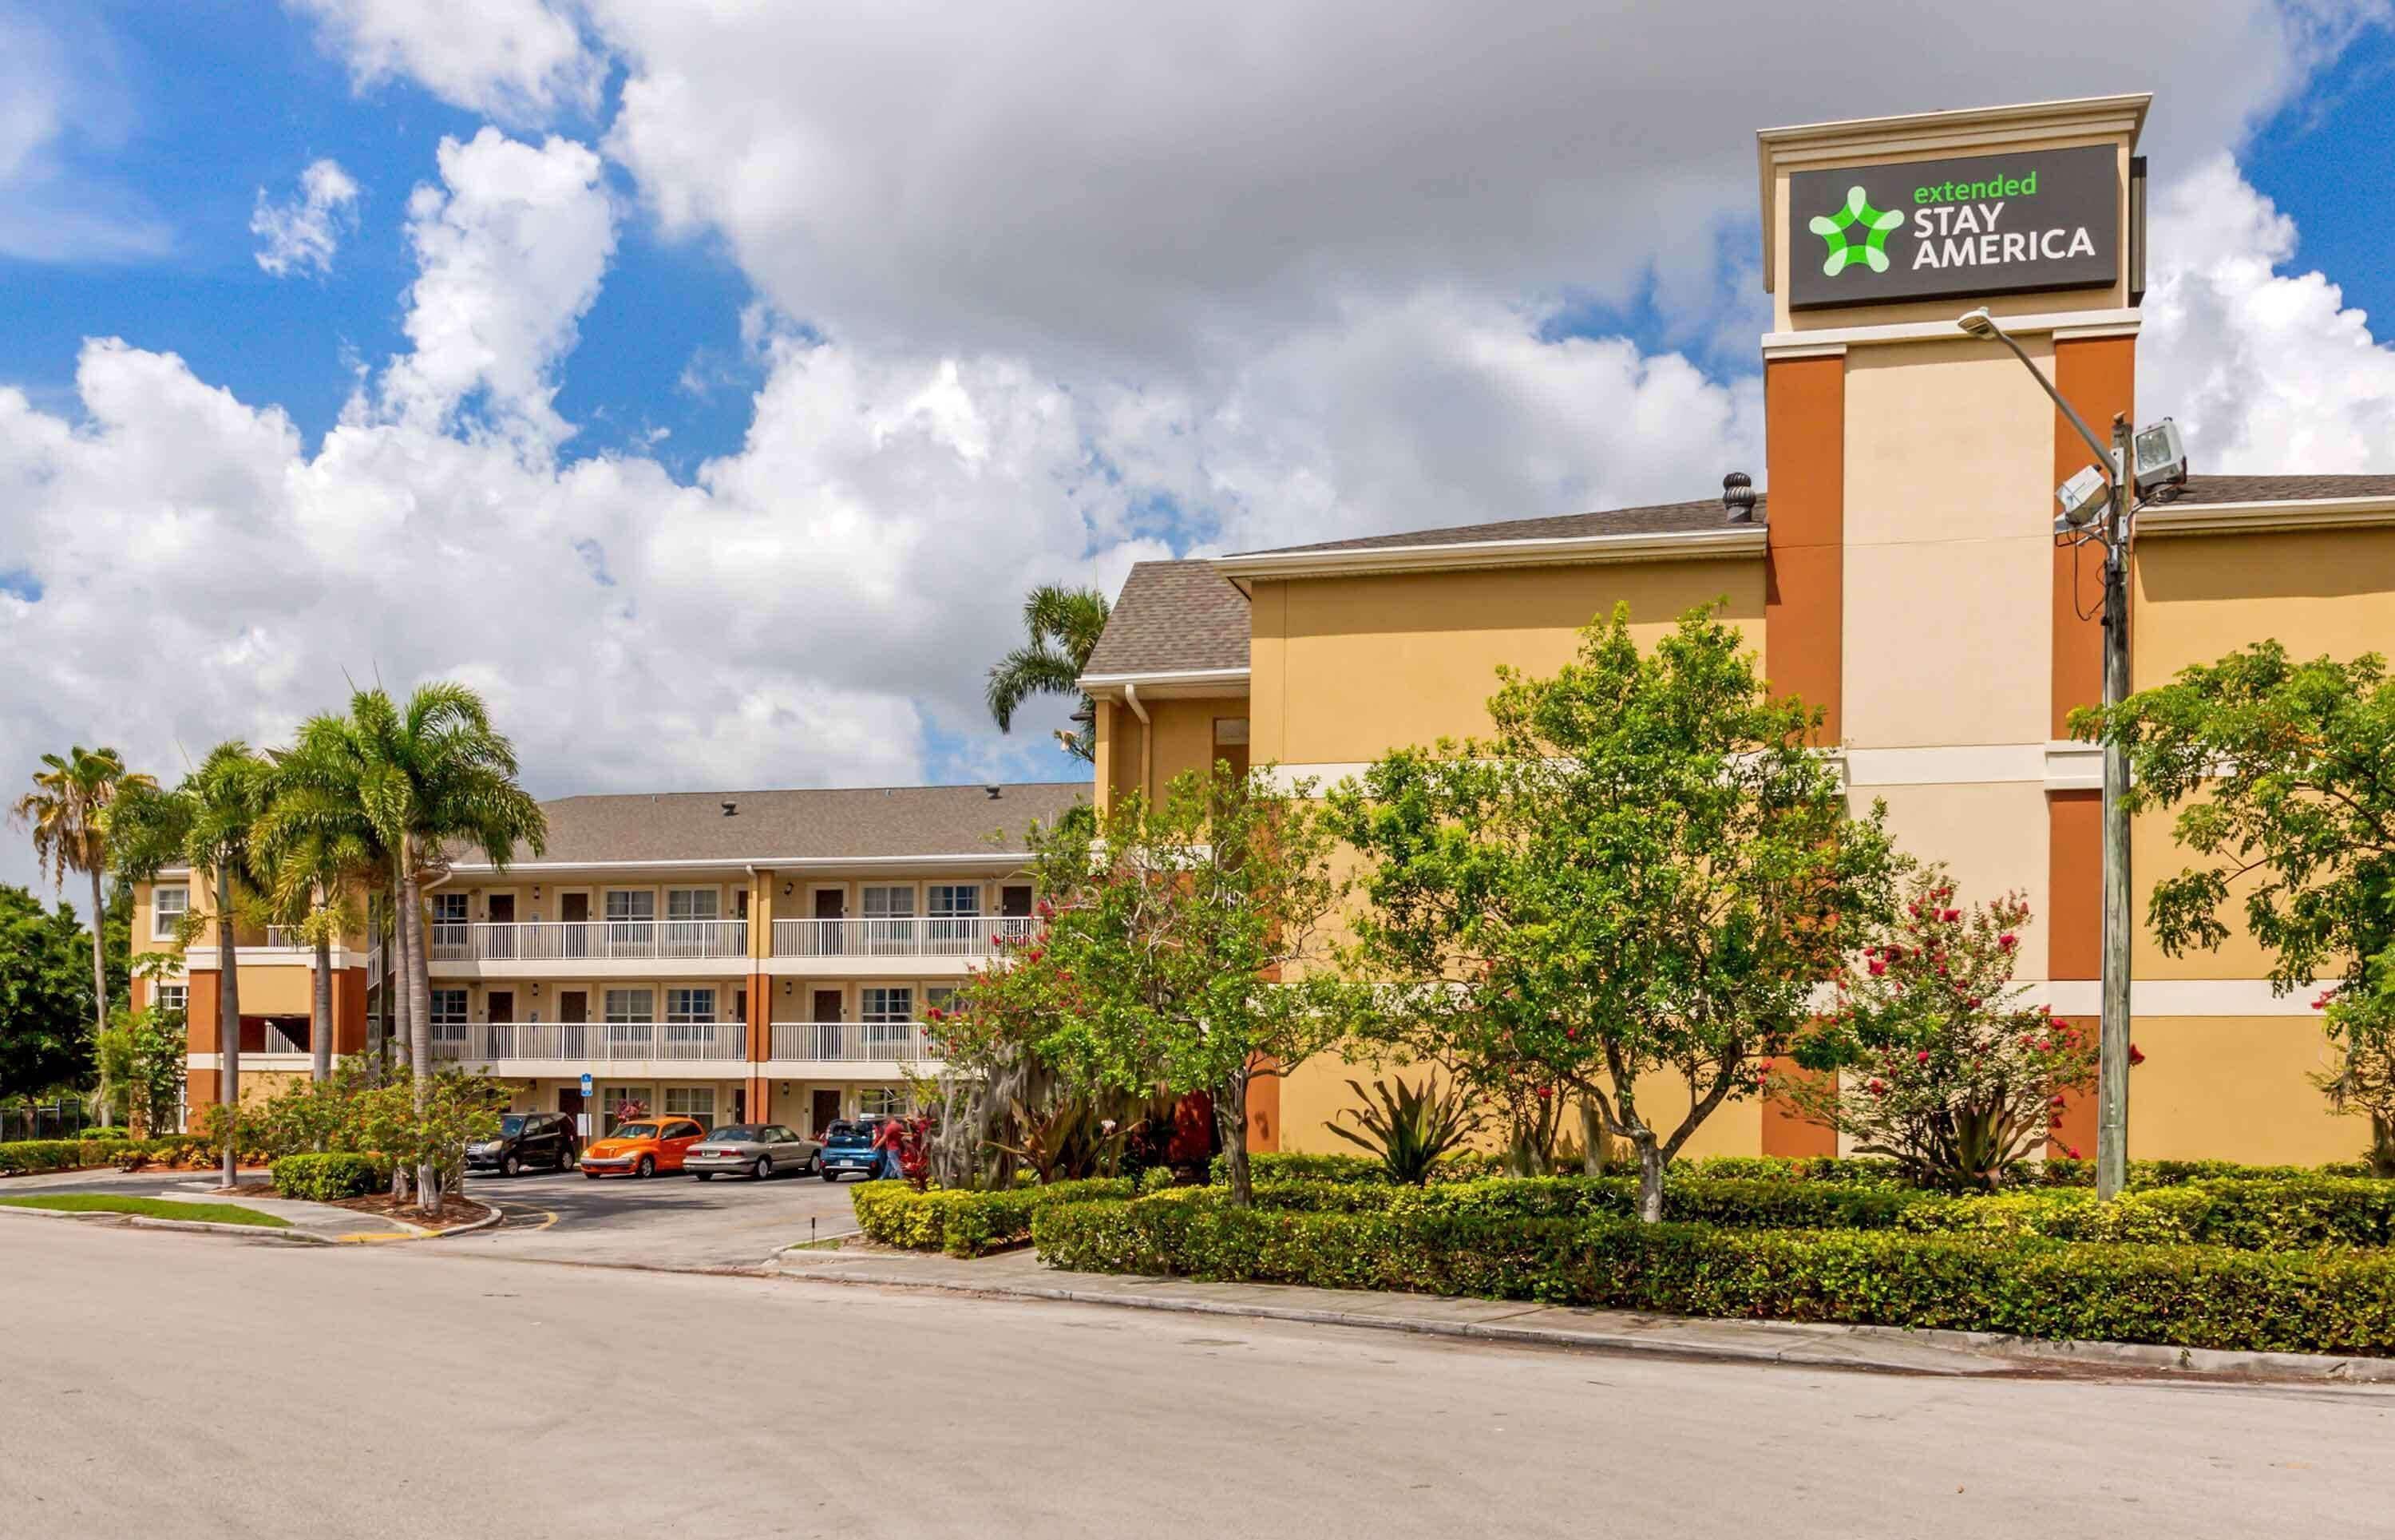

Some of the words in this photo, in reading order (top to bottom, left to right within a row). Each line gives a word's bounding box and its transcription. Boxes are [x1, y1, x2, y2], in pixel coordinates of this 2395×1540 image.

[1914, 169, 2037, 204] extended
[1914, 202, 2005, 239] STAY
[1912, 227, 2096, 270] AMERICA
